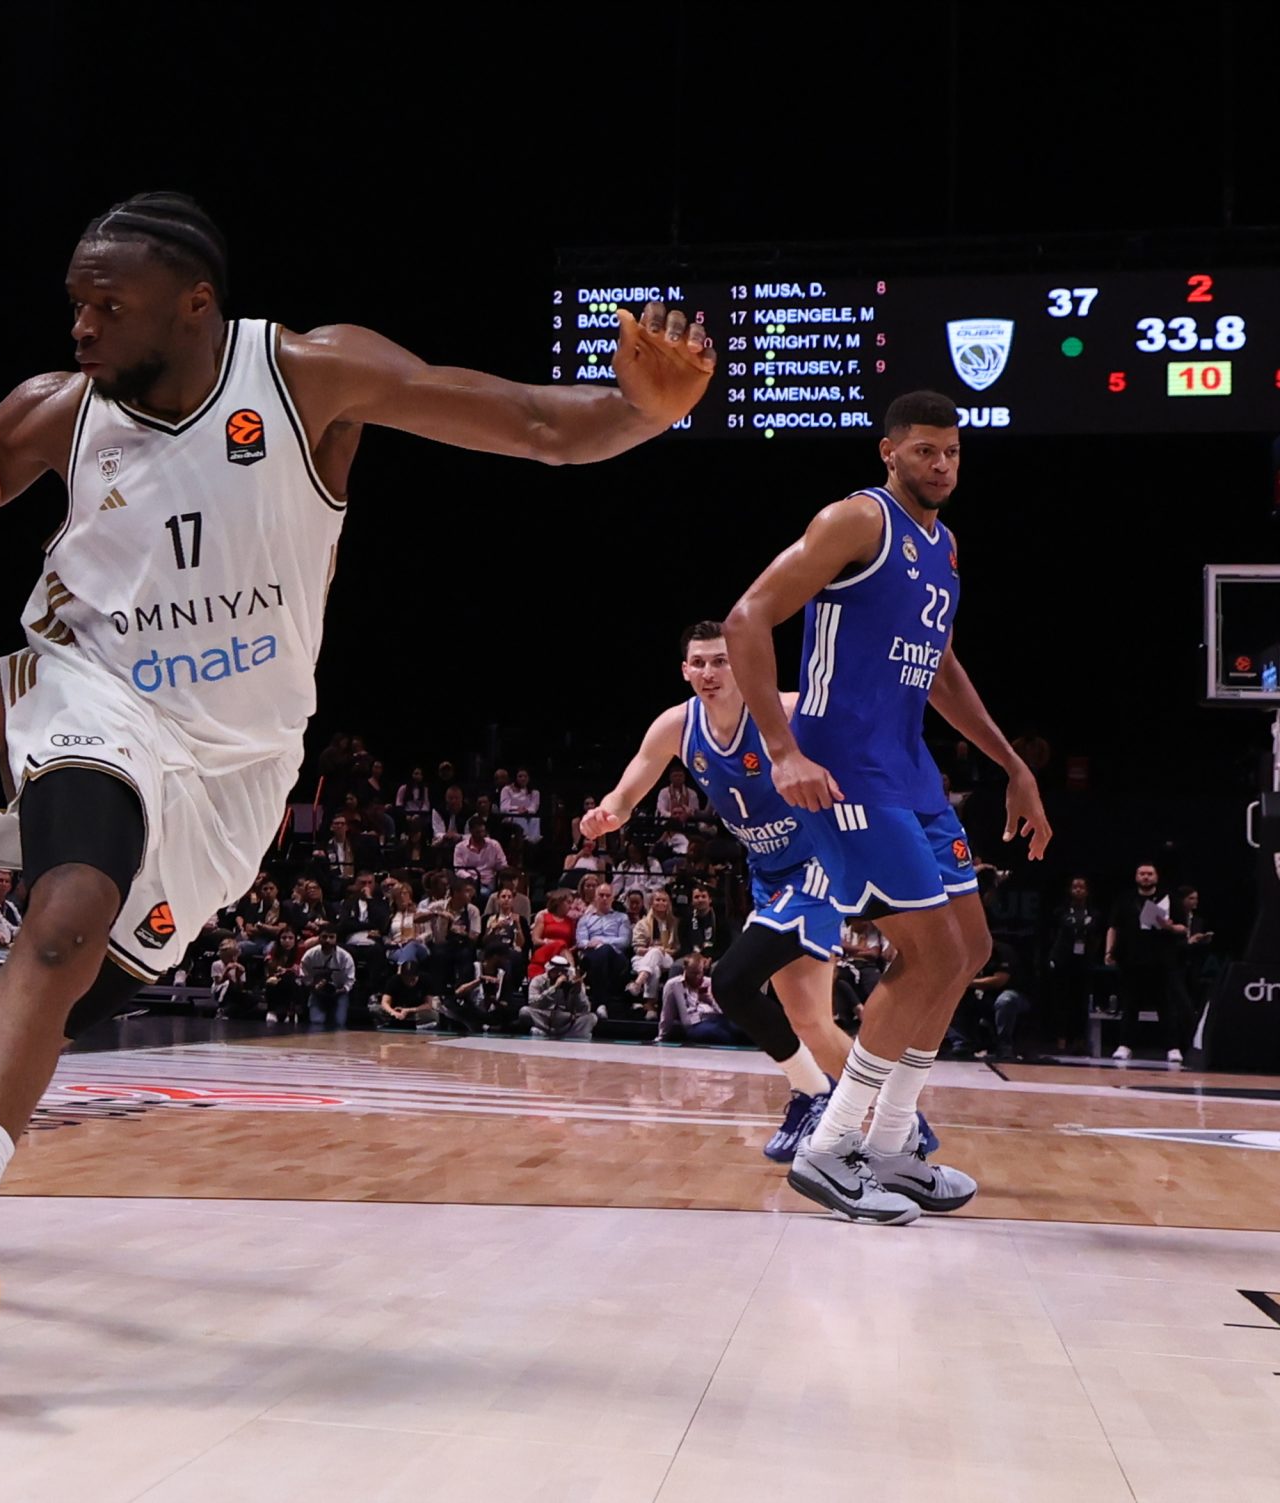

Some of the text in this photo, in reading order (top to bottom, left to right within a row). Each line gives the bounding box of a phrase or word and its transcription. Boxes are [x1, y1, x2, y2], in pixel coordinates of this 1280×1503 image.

[553, 286, 685, 304] 2 DANGUBIC, N.
[730, 286, 747, 299] 13
[755, 283, 805, 298] MUSA,
[876, 281, 886, 294] 8
[1187, 275, 1213, 302] 2
[1047, 288, 1098, 317] 37
[553, 316, 562, 329] 3
[696, 311, 705, 324] 5
[730, 307, 874, 325] 17 KABENGELE, M
[728, 333, 885, 350] 25 WRIGHT IV, M 5
[1135, 315, 1246, 352] 33.8
[552, 341, 561, 354] 4
[552, 367, 561, 379] 5
[728, 363, 747, 376] 30
[754, 361, 843, 376] PETRUSEV,
[876, 360, 885, 373] 9
[1108, 372, 1127, 392] 5
[1178, 367, 1222, 390] 10
[728, 386, 864, 402] 34 KAMENJAS, K.
[727, 414, 744, 428] 51
[753, 413, 836, 428] CABOCLO,
[165, 511, 202, 570] 17
[110, 584, 283, 635] OMNIYAT
[921, 583, 950, 633] 22
[132, 634, 276, 692] dnata
[729, 787, 749, 818] 1
